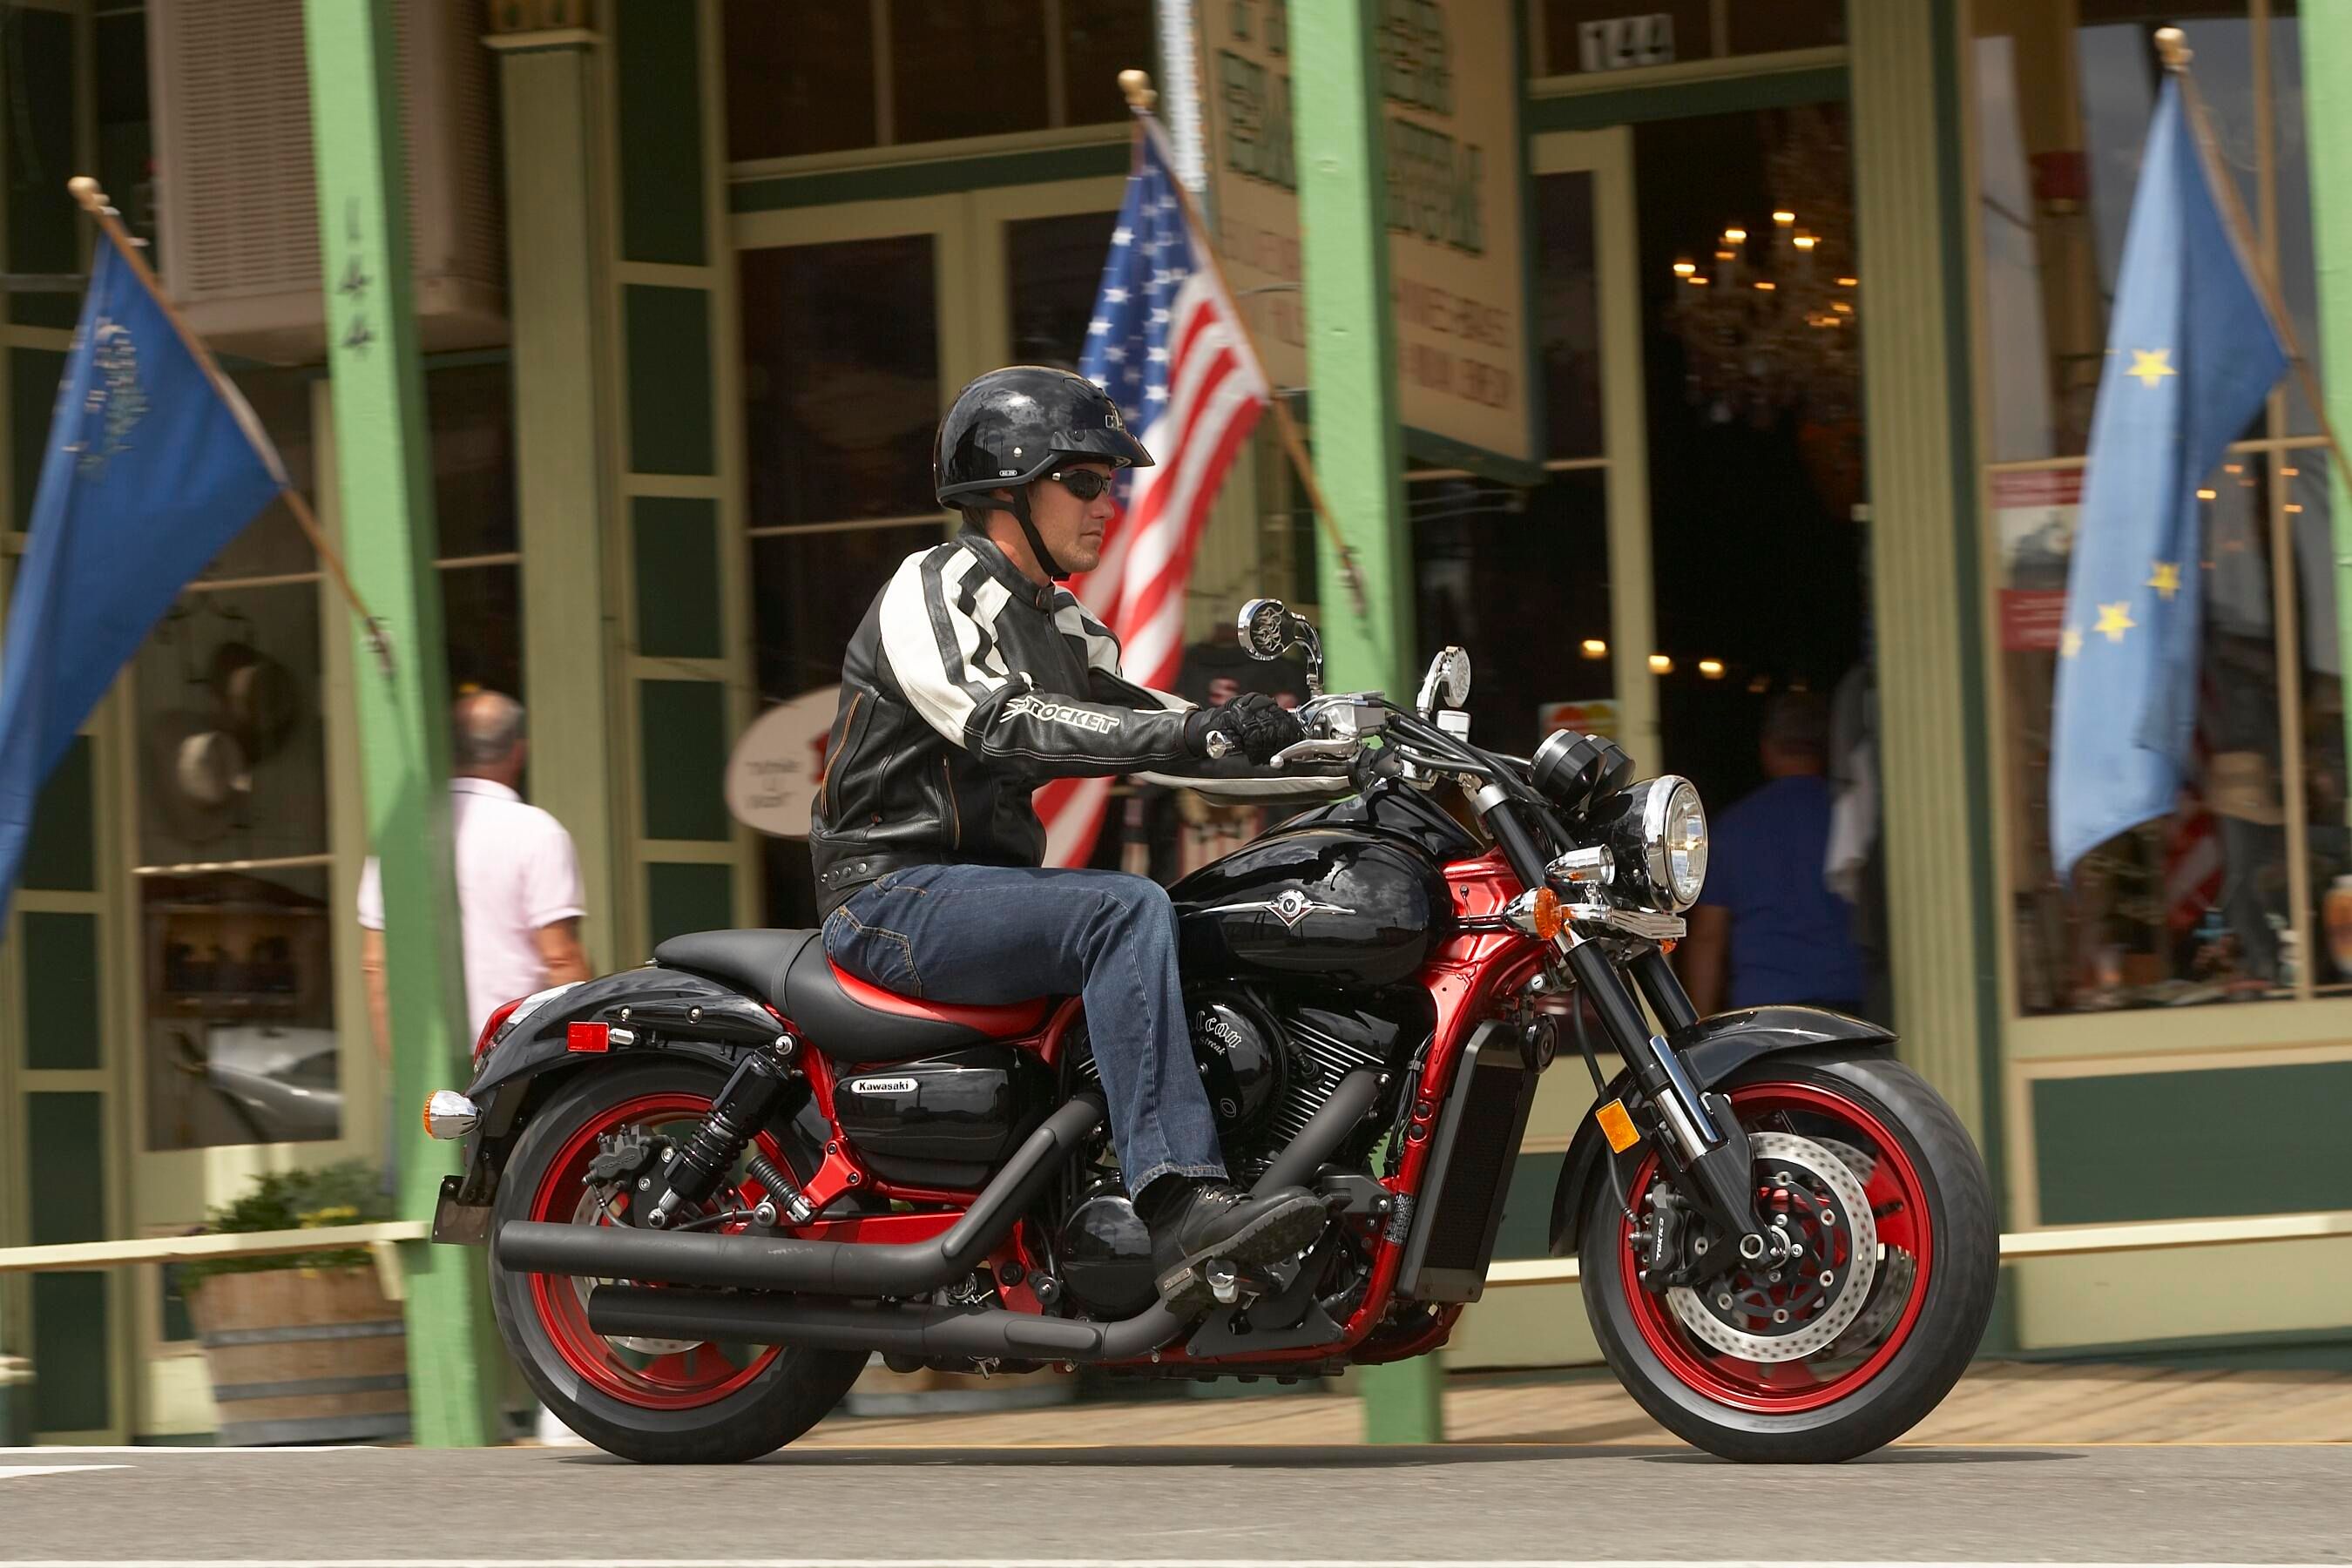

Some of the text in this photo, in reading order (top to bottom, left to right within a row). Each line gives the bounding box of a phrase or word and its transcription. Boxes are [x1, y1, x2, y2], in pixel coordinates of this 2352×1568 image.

[1585, 18, 1673, 70] 144
[336, 196, 376, 359] 144
[1025, 695, 1120, 733] ROCKET
[1200, 1036, 1226, 1056] Streak
[859, 1080, 909, 1091] Kawasaki
[1655, 1217, 1664, 1261] TOKICO
